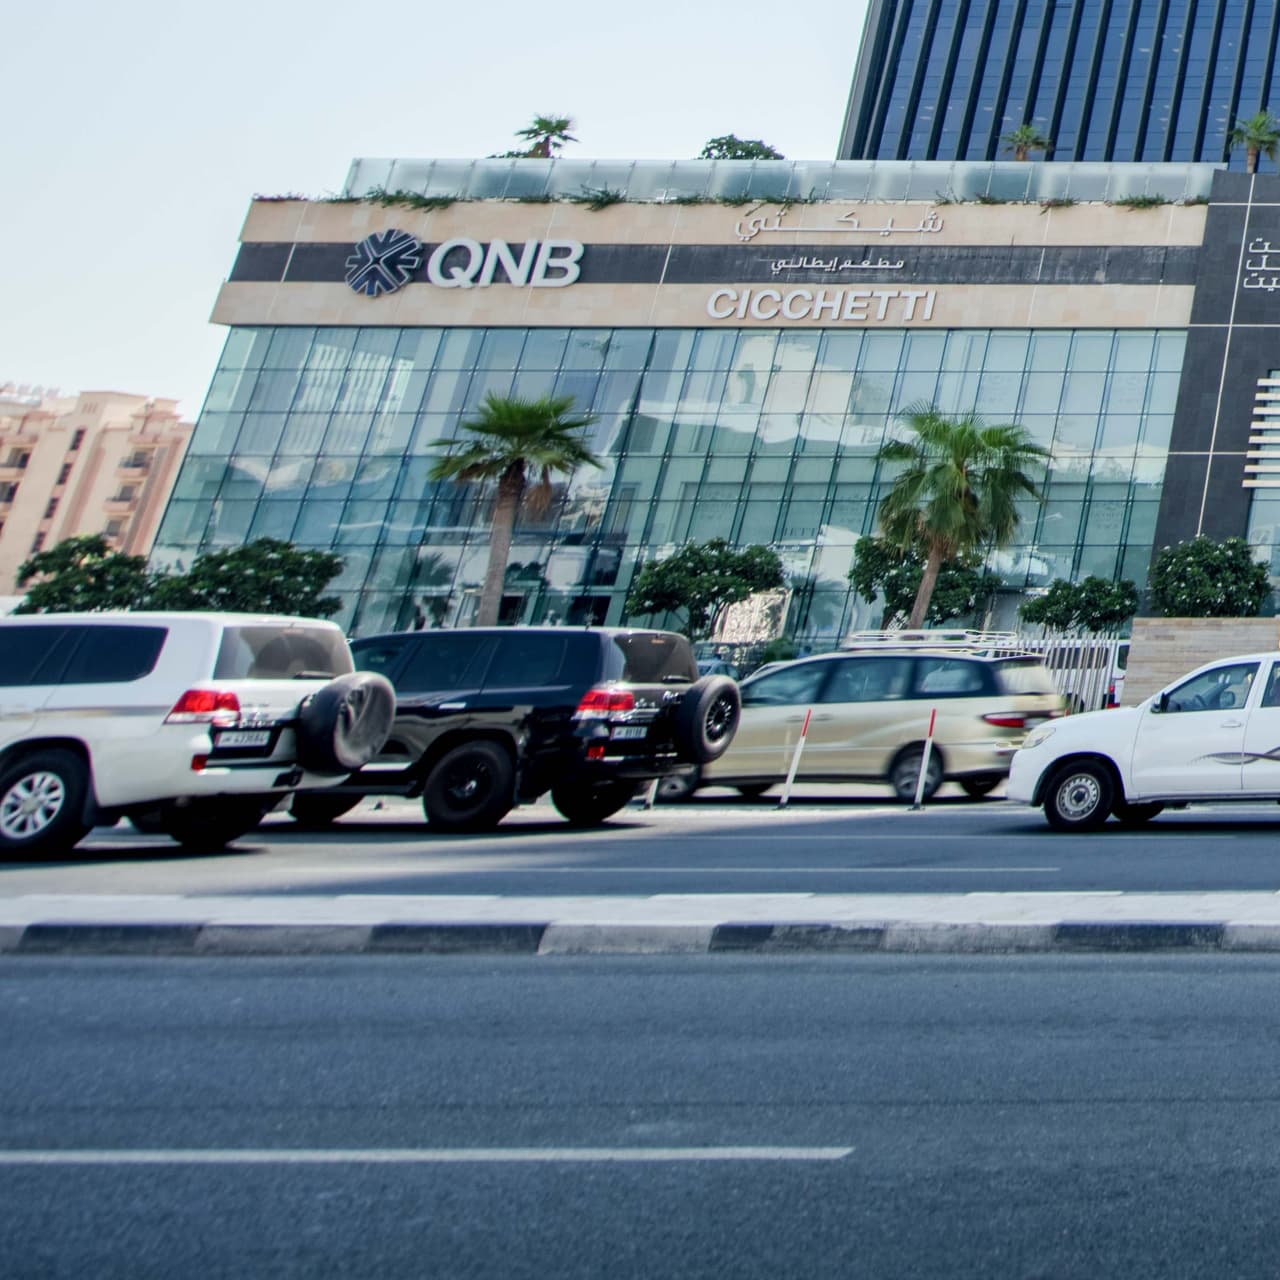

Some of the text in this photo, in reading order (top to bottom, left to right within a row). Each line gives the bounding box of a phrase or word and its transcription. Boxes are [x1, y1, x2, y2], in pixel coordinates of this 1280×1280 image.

[427, 237, 585, 289] QNB
[839, 257, 905, 271] مطعم
[706, 288, 937, 321] CICCHETTI
